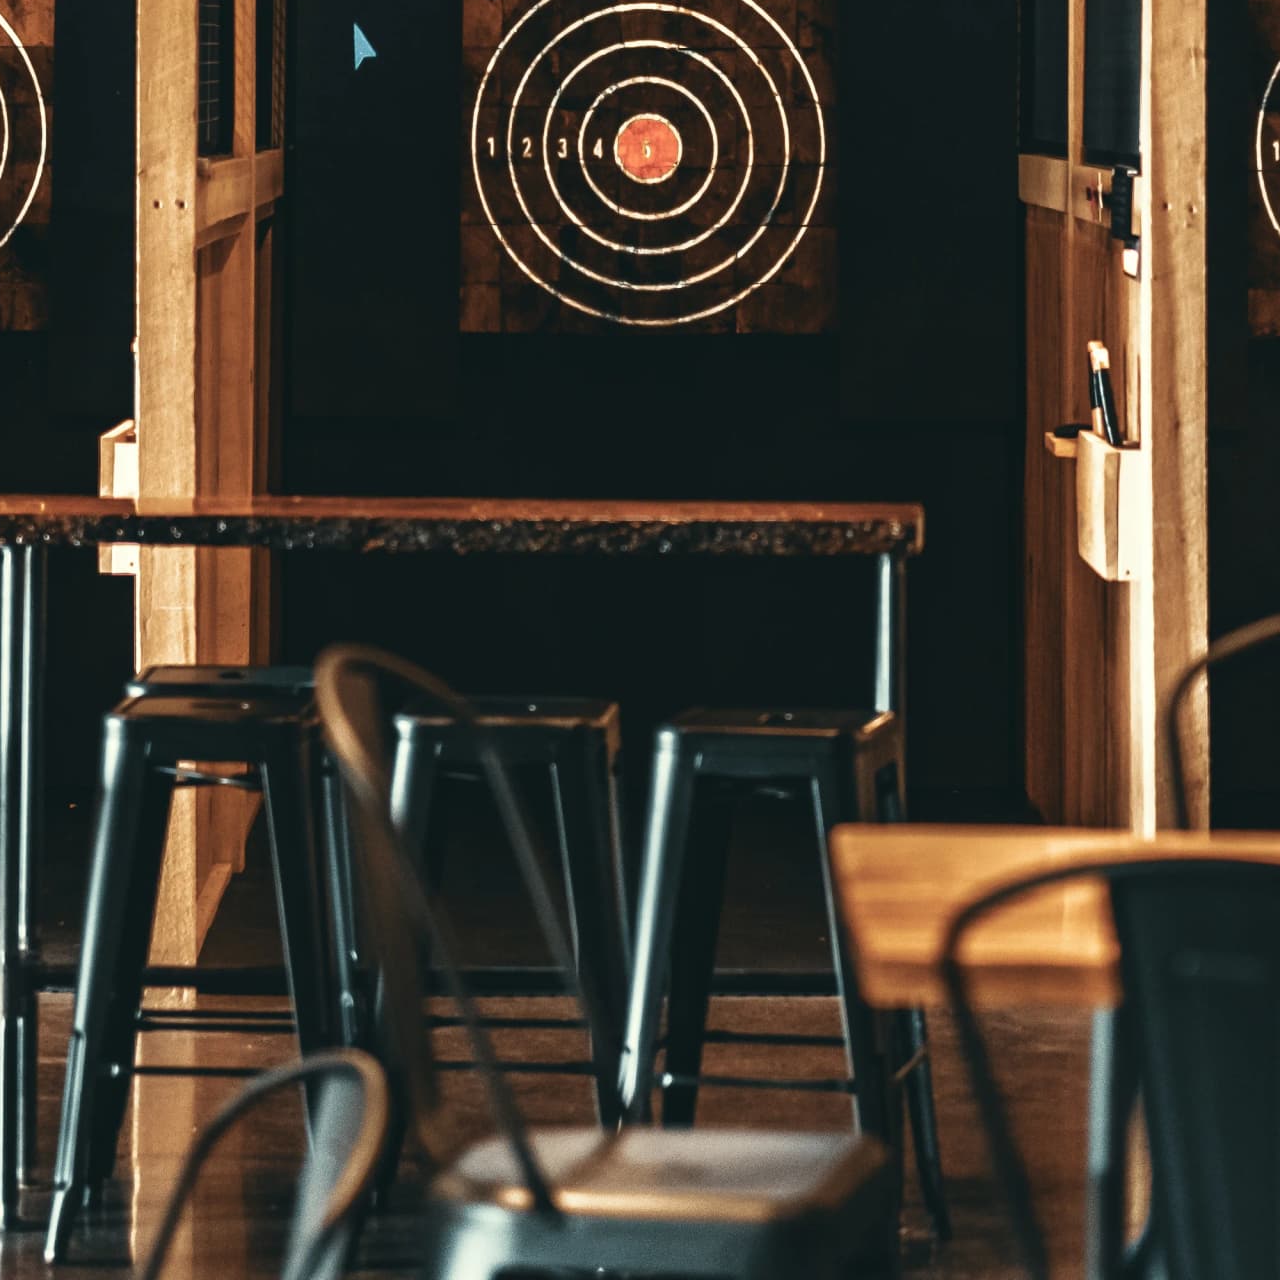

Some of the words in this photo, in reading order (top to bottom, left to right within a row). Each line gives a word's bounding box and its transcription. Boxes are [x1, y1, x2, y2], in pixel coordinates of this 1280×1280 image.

[487, 136, 495, 157] 1
[522, 137, 532, 158] 2
[558, 138, 567, 159] 3
[593, 138, 603, 159] 4
[1272, 140, 1280, 161] 1
